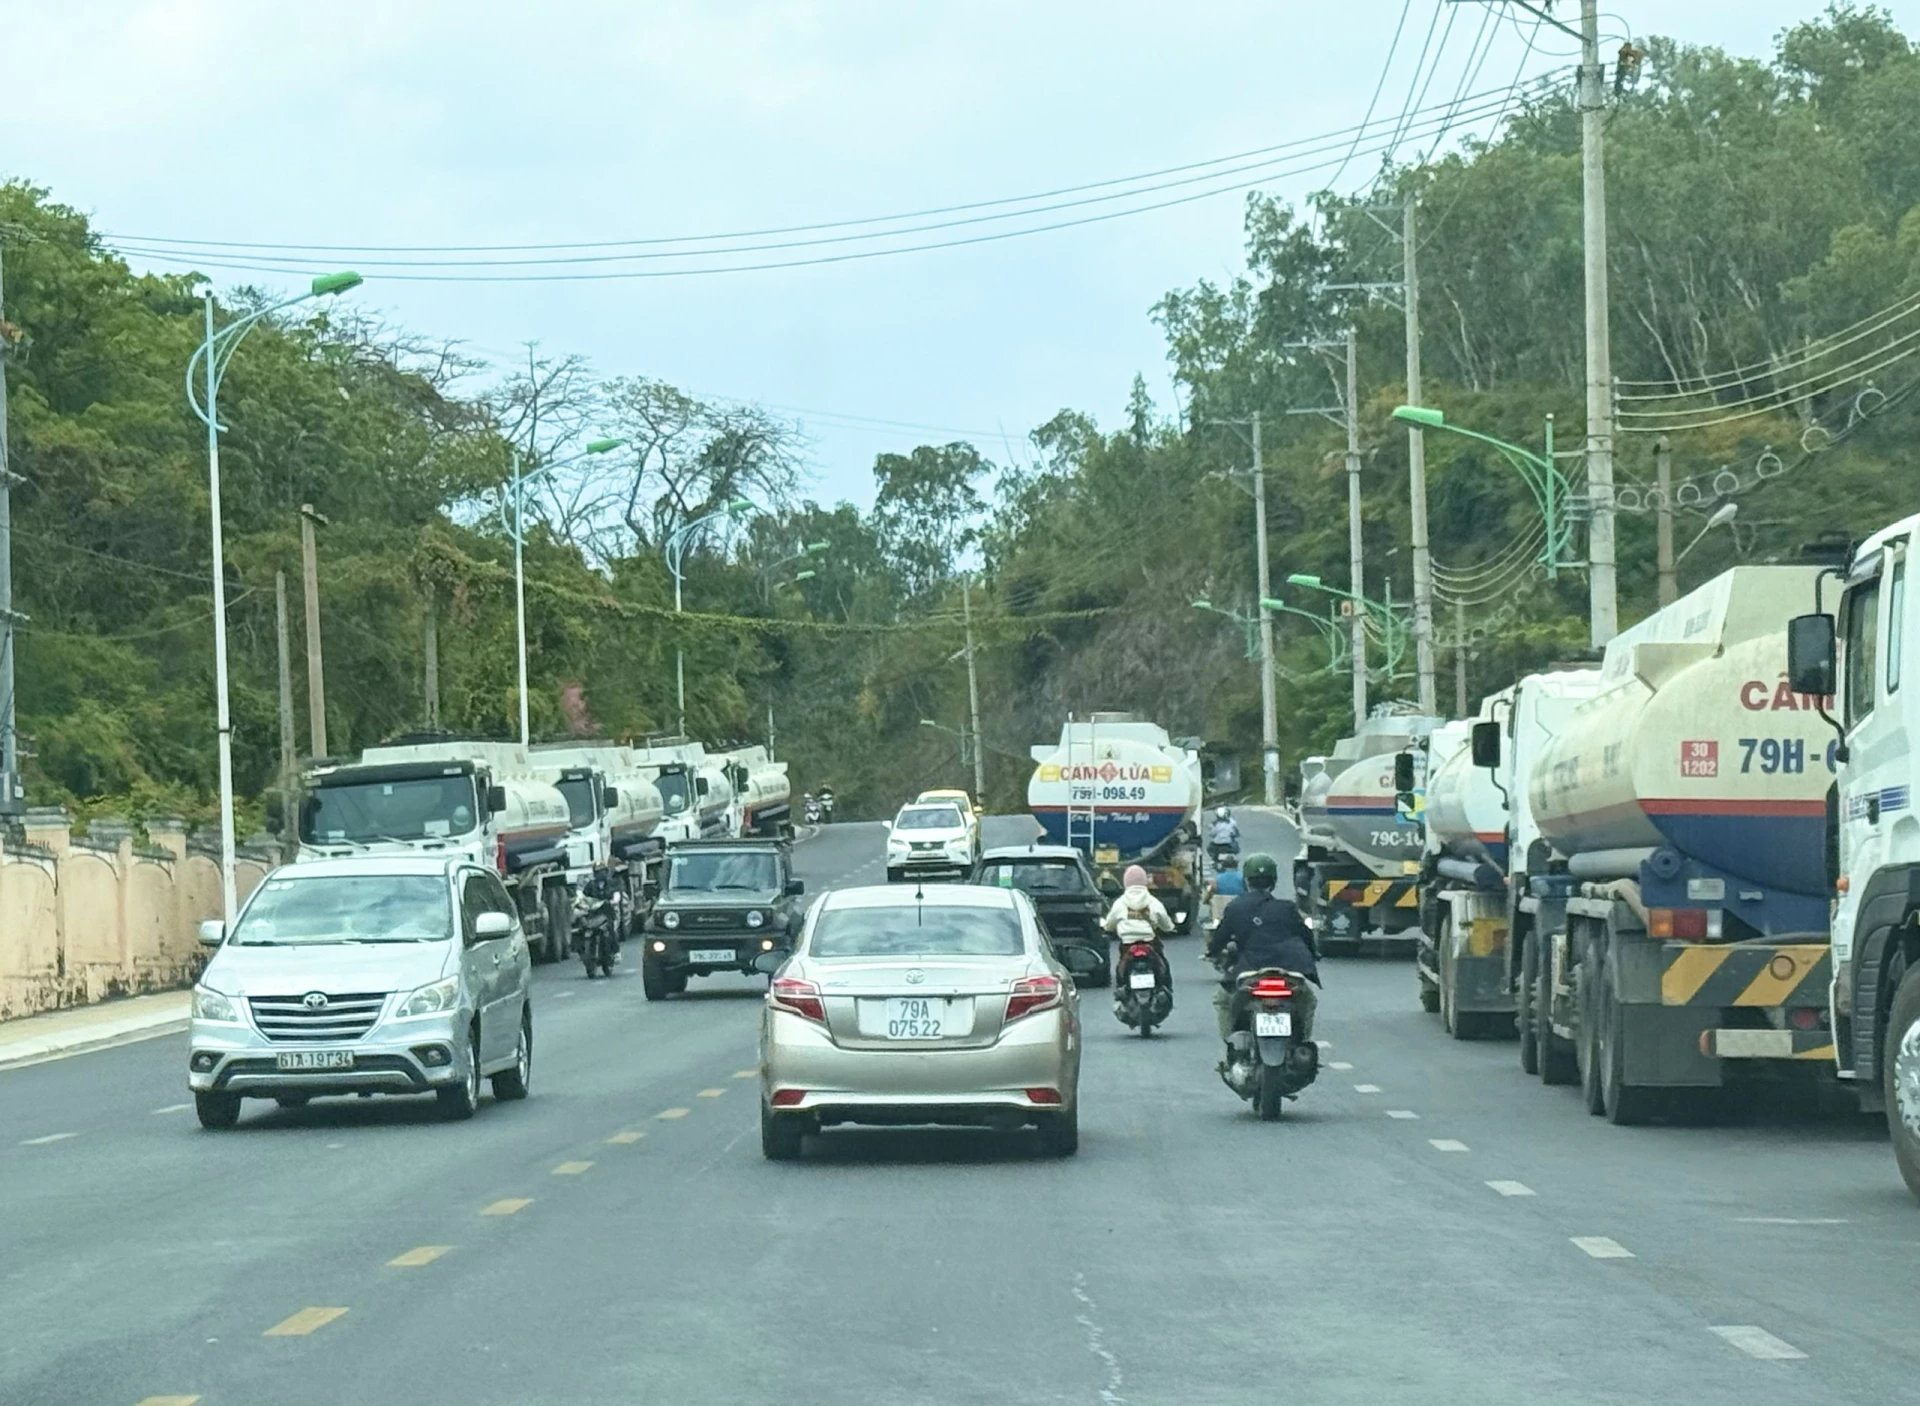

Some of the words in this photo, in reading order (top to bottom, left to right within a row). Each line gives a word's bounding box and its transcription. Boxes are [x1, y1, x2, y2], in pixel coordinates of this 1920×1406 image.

[1690, 742, 1709, 757] 30
[1682, 759, 1717, 776] 1202
[900, 1001, 930, 1018] 79A
[889, 1020, 941, 1037] 075.22
